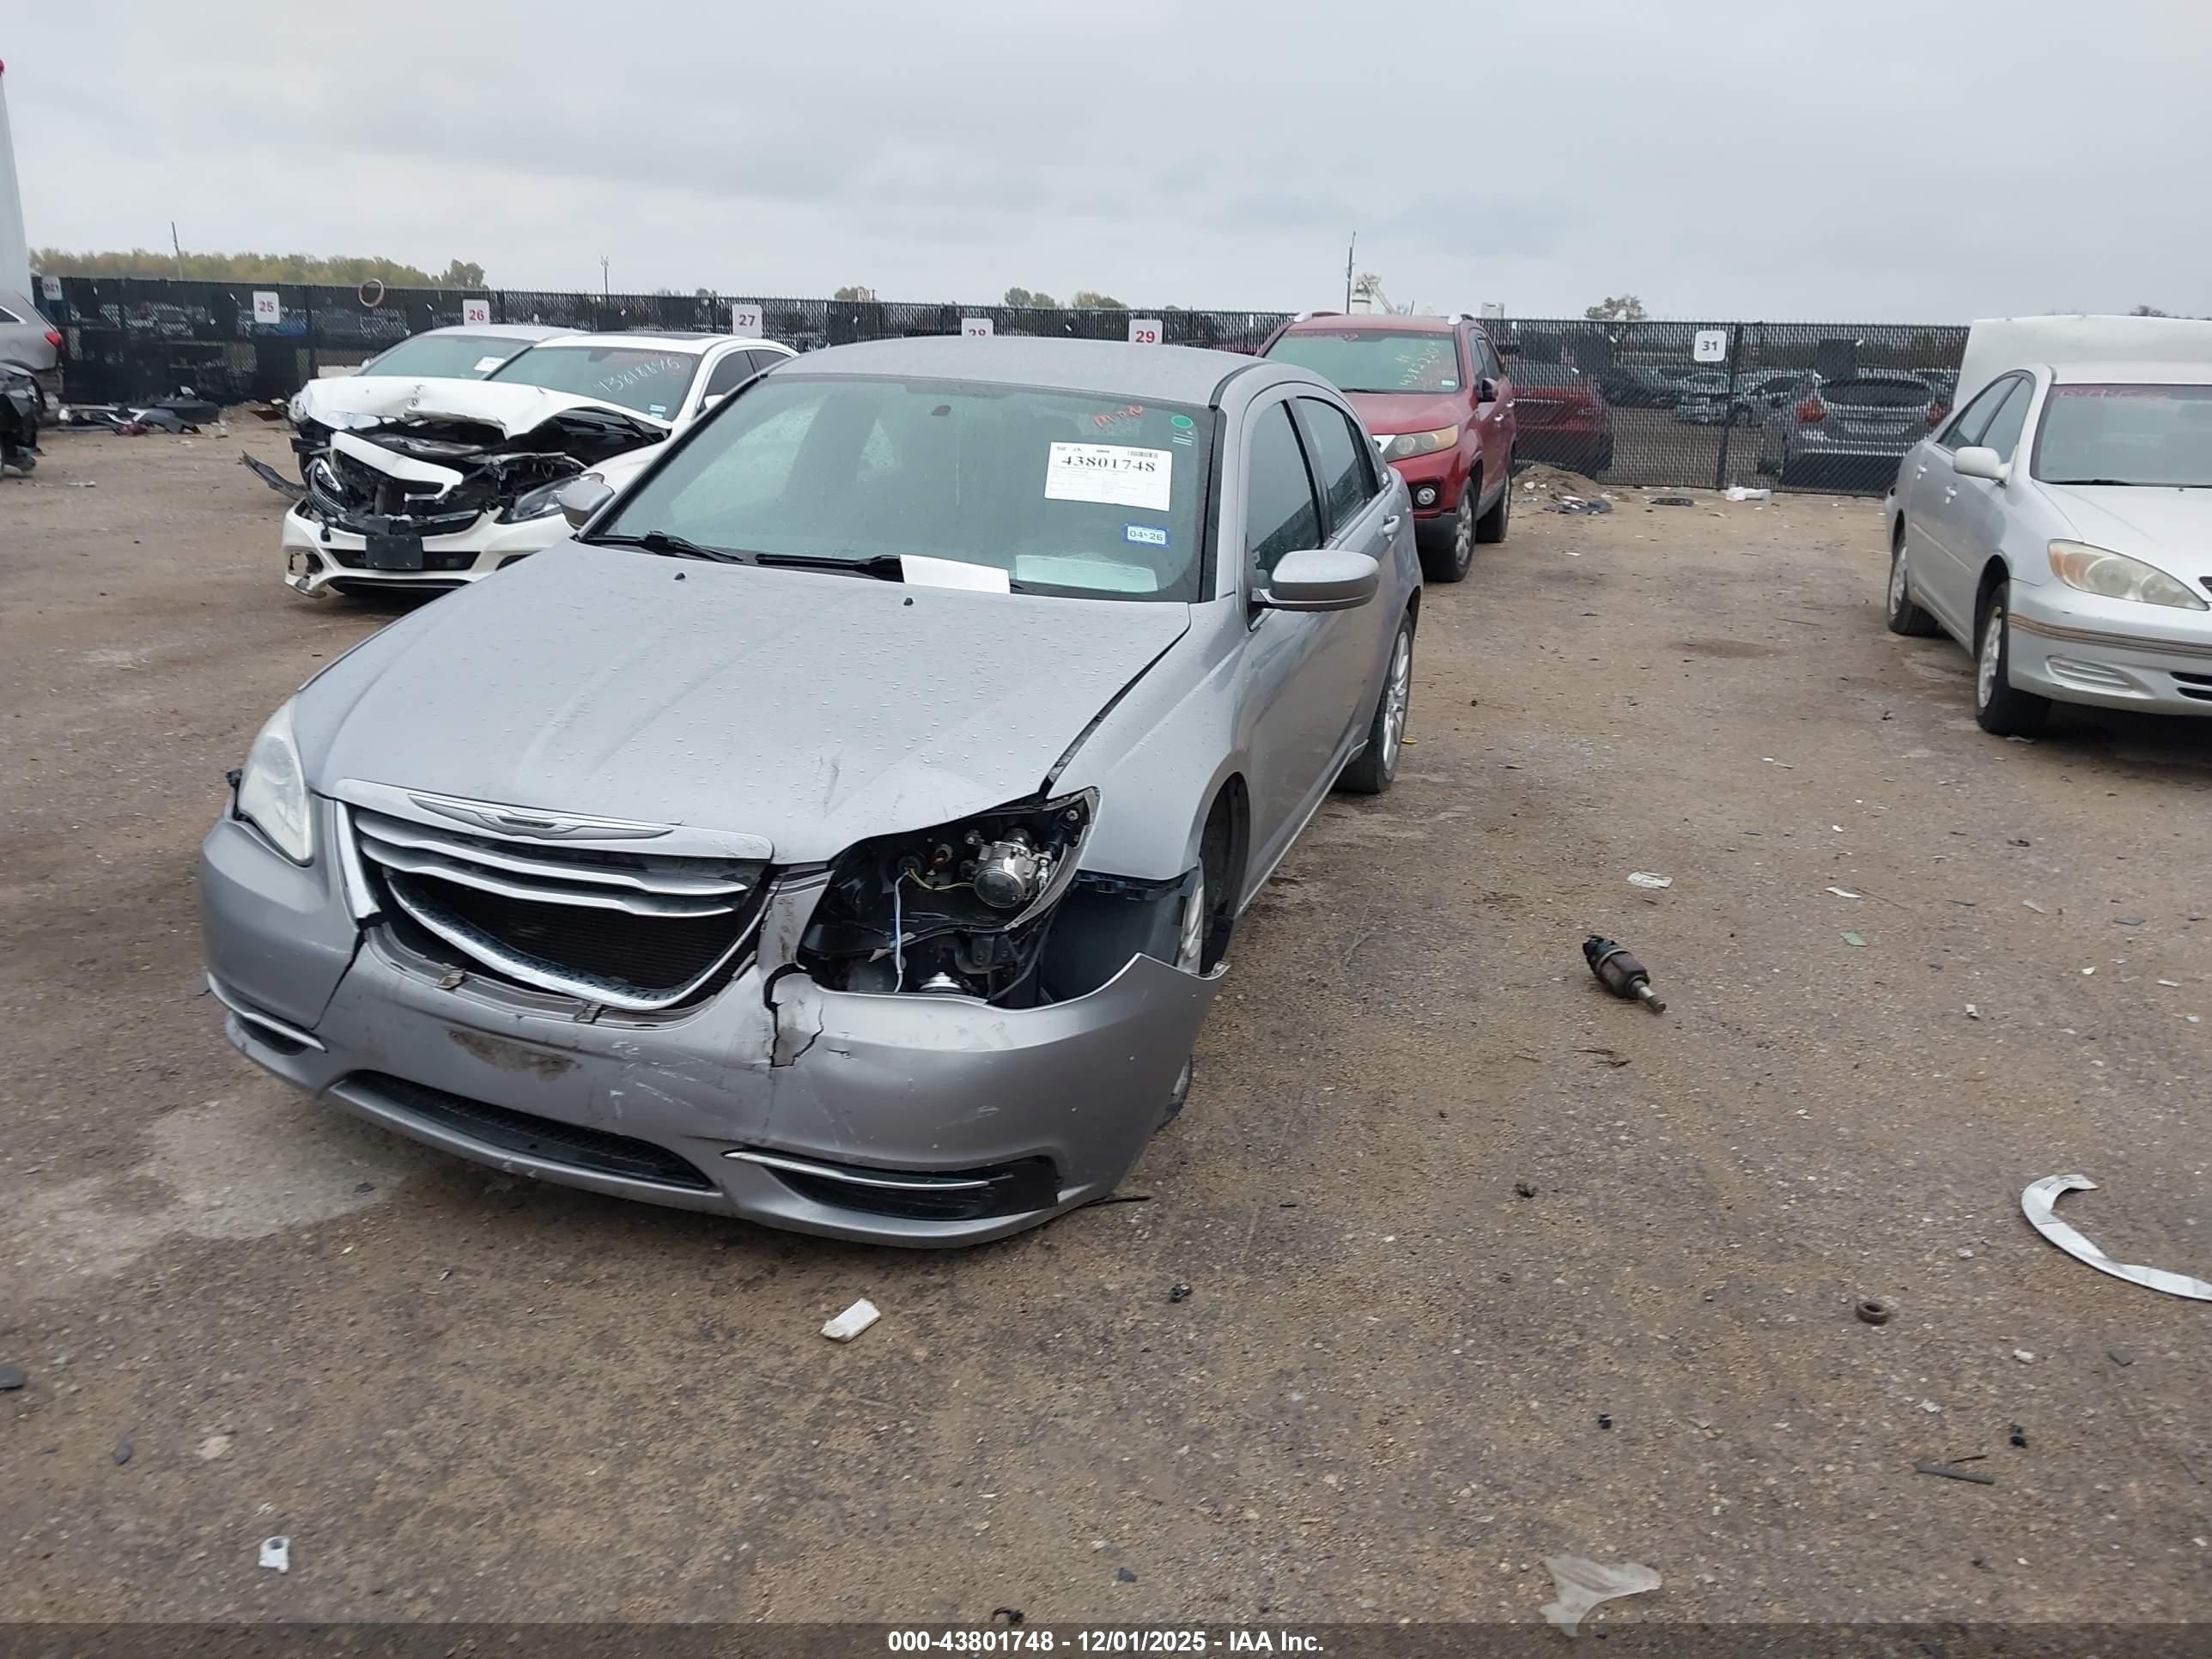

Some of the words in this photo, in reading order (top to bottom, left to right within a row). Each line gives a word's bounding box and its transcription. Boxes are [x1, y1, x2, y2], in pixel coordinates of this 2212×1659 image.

[260, 301, 274, 313] 25
[469, 309, 484, 321] 26
[738, 314, 756, 326] 27
[1135, 331, 1155, 343] 29
[1702, 340, 1717, 351] 31
[1061, 455, 1156, 472] 43801748
